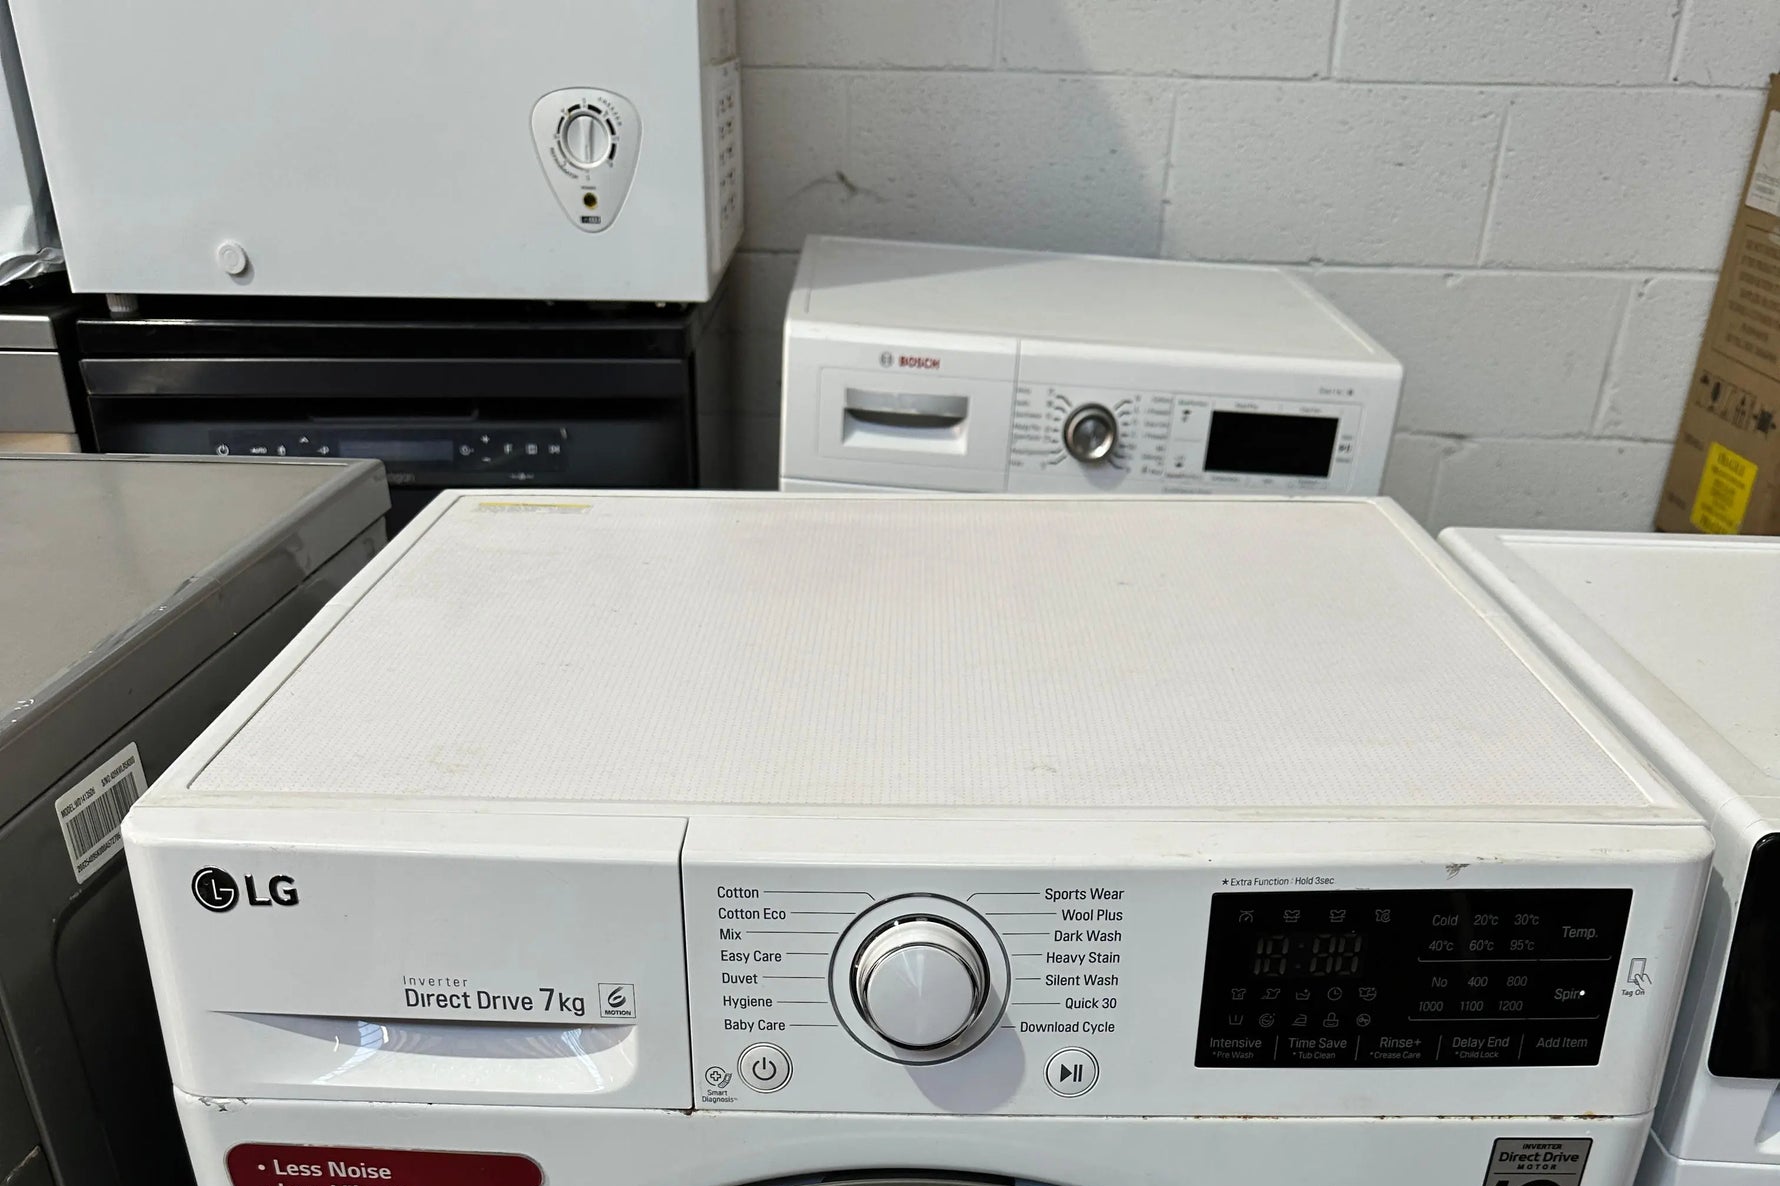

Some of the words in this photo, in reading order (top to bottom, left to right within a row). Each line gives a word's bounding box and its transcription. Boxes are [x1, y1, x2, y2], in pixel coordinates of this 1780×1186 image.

[899, 356, 940, 369] BOSCH
[1230, 878, 1252, 887] Extra
[1253, 877, 1289, 886] Function
[1294, 876, 1314, 886] Hold
[1315, 876, 1335, 885] 3sec
[245, 873, 299, 906] LG
[717, 886, 759, 899] Cotton
[1045, 888, 1087, 902] Sports
[1090, 888, 1125, 900] Wear
[718, 907, 760, 920] Cotton
[763, 908, 786, 920] Eco
[1062, 909, 1094, 921] Wool
[1096, 909, 1123, 921] Plus
[1432, 914, 1458, 926] Cold
[719, 928, 742, 940] Mix
[1054, 930, 1083, 942] Dark
[1086, 930, 1122, 942] Wash
[721, 950, 750, 964] Easy
[753, 950, 782, 962] Care
[1046, 952, 1086, 966] Heavy
[1088, 952, 1120, 964] Stain
[403, 975, 468, 987] Inverter
[722, 972, 758, 984] Duvet
[1045, 974, 1081, 986] Silent
[1083, 974, 1119, 986] Wash
[1432, 977, 1448, 988] No
[1467, 976, 1488, 987] 400
[1506, 976, 1528, 987] 800
[1621, 989, 1633, 997] Tag
[405, 988, 471, 1010] Direct
[476, 990, 534, 1011] Drive
[723, 995, 773, 1010] Hygiene
[1065, 997, 1099, 1010] Quick
[1102, 998, 1117, 1009] 30
[1418, 1001, 1444, 1012] 1000
[1460, 1001, 1484, 1012] 1100
[1499, 1000, 1523, 1011] 1200
[724, 1019, 755, 1032] Baby
[757, 1019, 786, 1031] Care
[1020, 1021, 1079, 1033] Download
[1082, 1021, 1115, 1035] Cycle
[1210, 1037, 1262, 1048] Intensive
[1288, 1037, 1316, 1048] Time
[1318, 1037, 1348, 1048] Save
[1379, 1036, 1422, 1048] Rinse+
[1452, 1036, 1485, 1049] Delay
[1488, 1036, 1510, 1048] End
[1536, 1036, 1560, 1048] Add
[1562, 1036, 1588, 1048] Item
[1230, 1051, 1254, 1059] Wash
[1314, 1051, 1336, 1059] Clean
[1402, 1051, 1421, 1059] Care
[1480, 1050, 1499, 1059] Lock
[1498, 1151, 1540, 1162] Direct
[1542, 1151, 1580, 1163] Drive
[273, 1159, 323, 1177] Less
[327, 1161, 392, 1180] Noise
